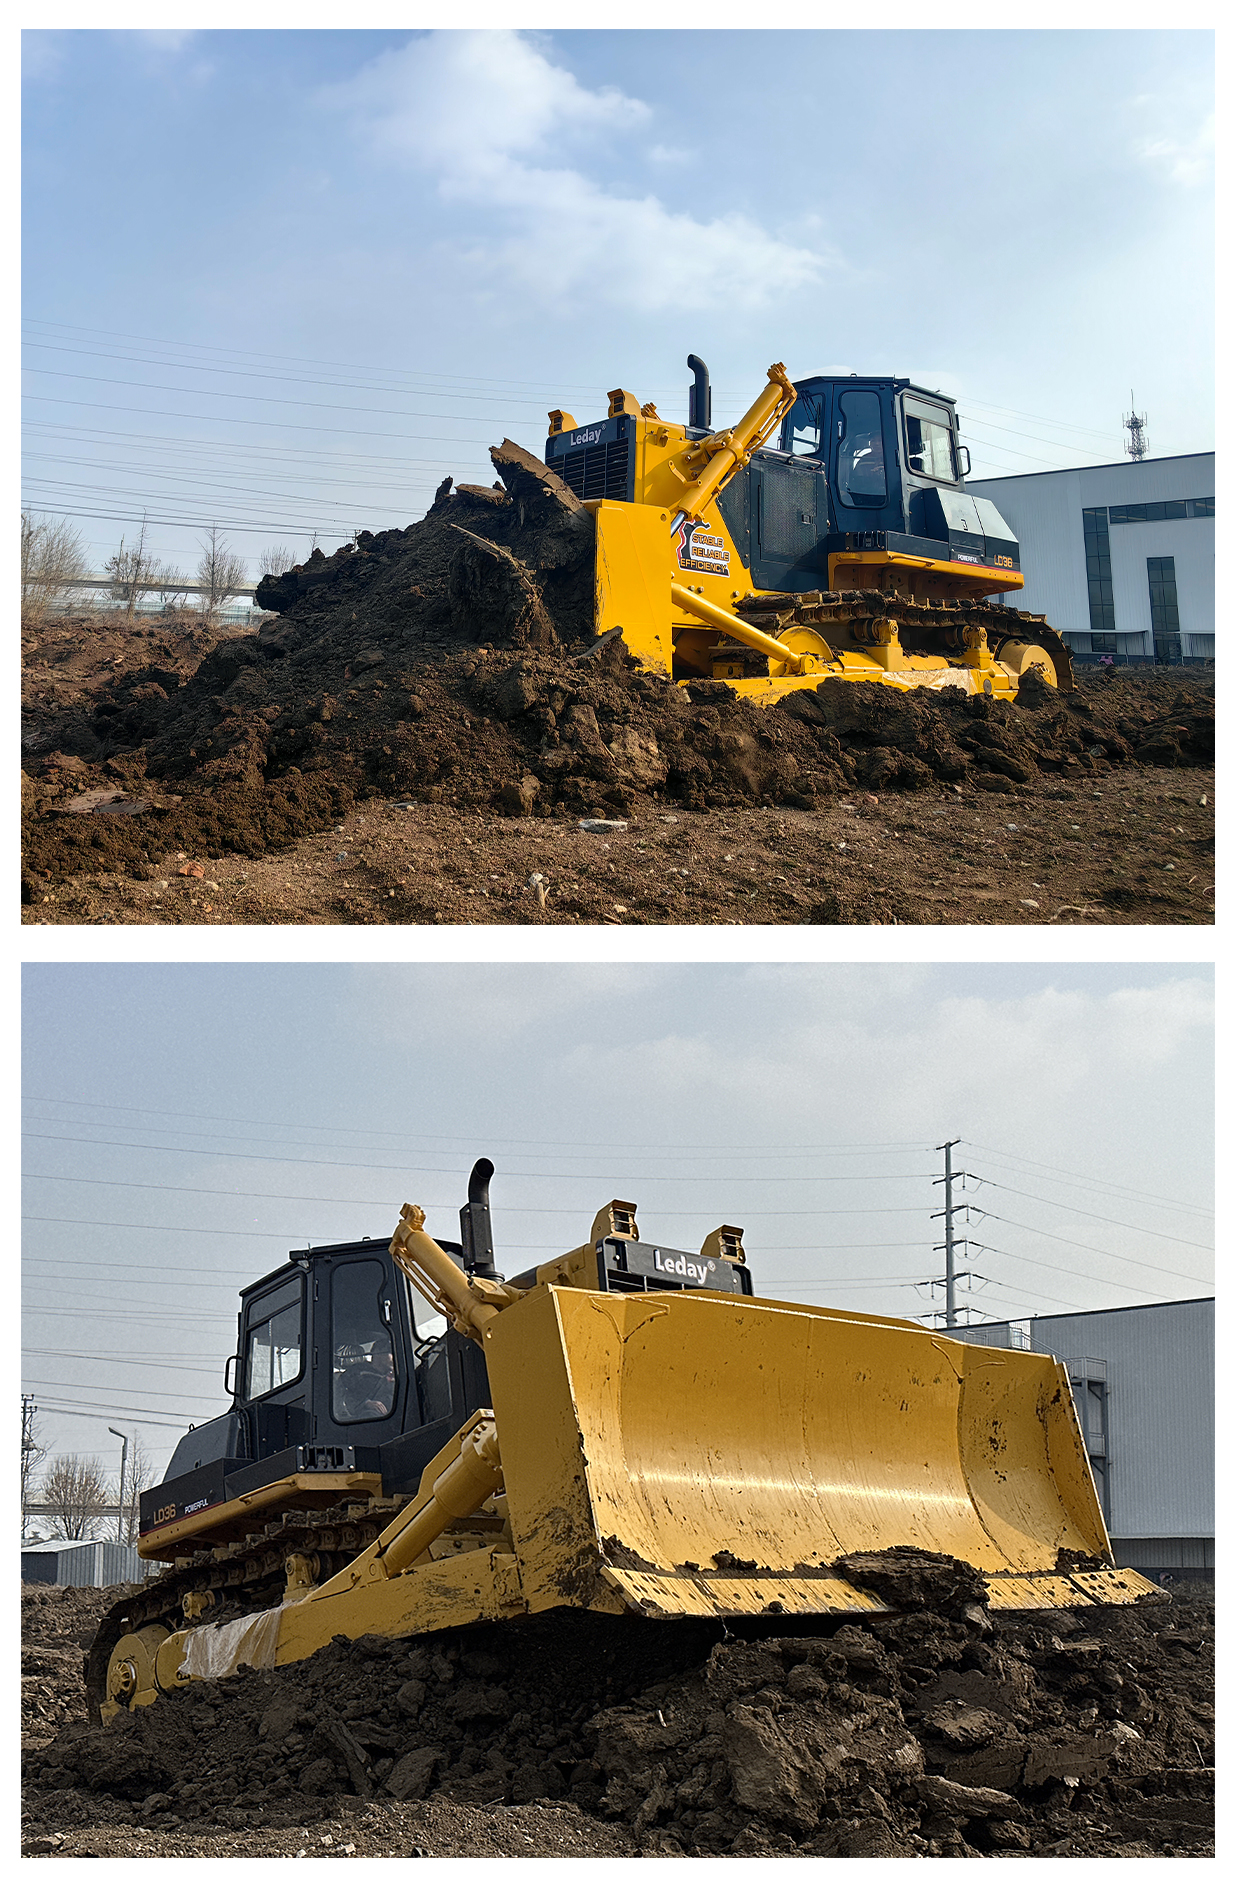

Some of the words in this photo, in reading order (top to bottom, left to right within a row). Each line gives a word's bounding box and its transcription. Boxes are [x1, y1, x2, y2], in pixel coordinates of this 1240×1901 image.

[692, 534, 723, 547] STABLE
[691, 546, 730, 561] RELIABLE
[957, 554, 978, 564] POWERFUL
[994, 554, 1013, 568] LD36
[680, 557, 727, 573] EFFICIENCY
[184, 1498, 209, 1514] POWERFUL
[153, 1503, 177, 1525] LD36
